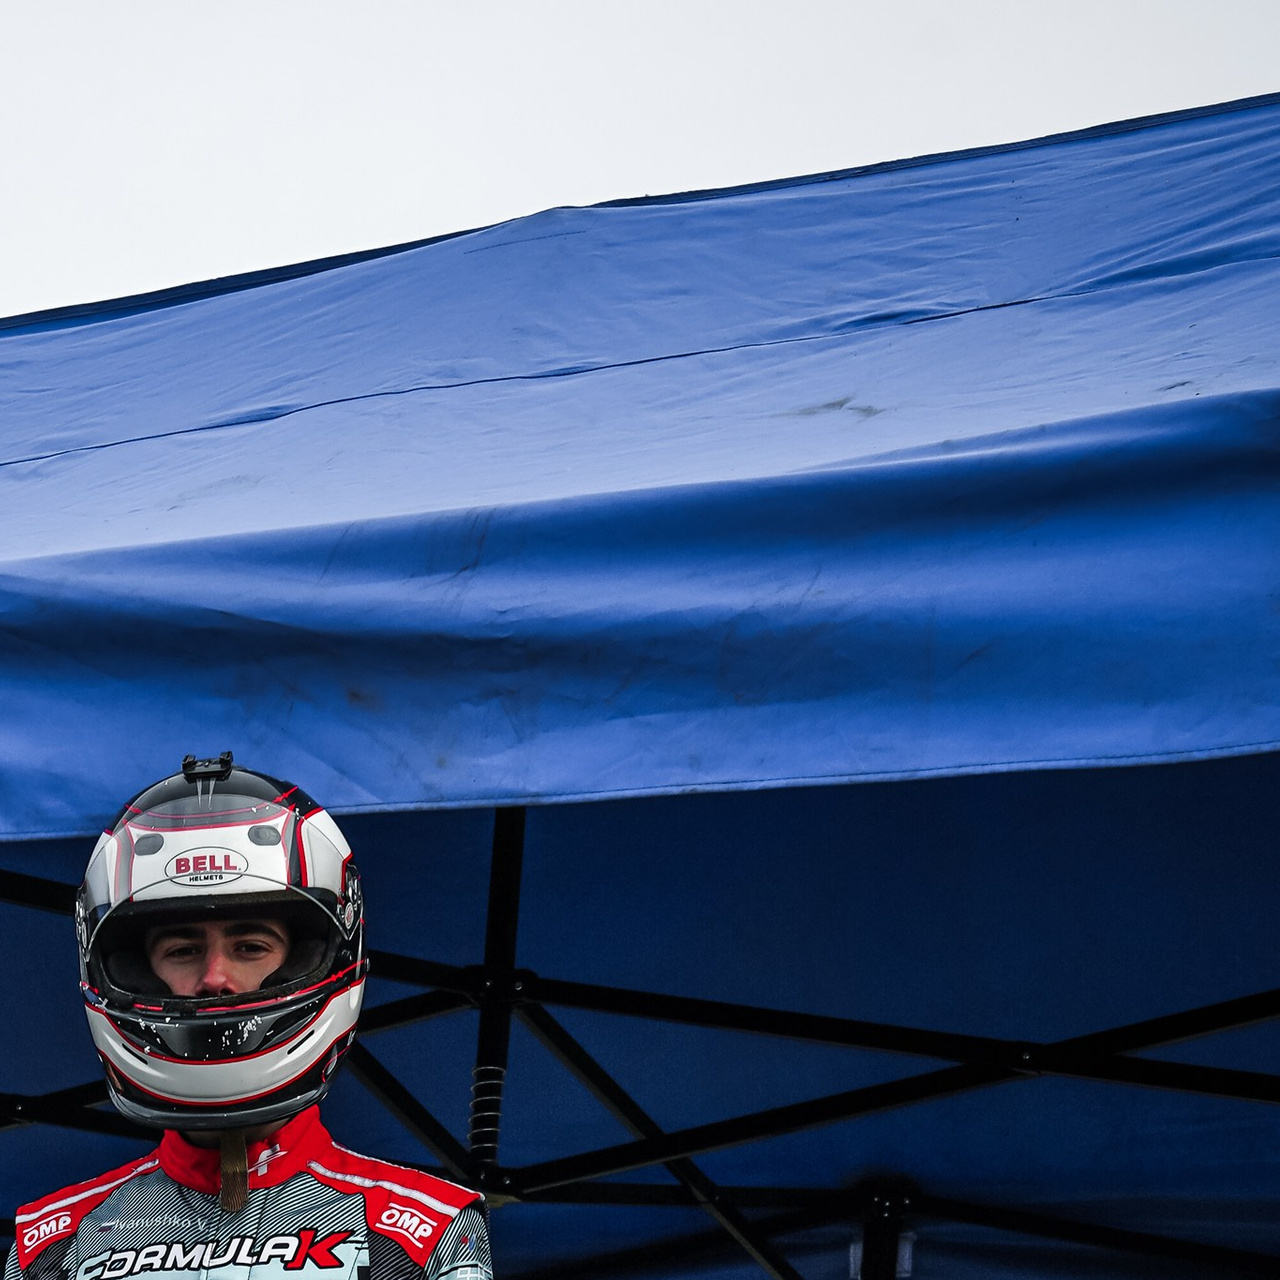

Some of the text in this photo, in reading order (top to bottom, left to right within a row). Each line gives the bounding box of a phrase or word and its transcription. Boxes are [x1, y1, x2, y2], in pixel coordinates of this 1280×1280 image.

[175, 855, 237, 874] BELL
[23, 1216, 71, 1247] OMP
[381, 1209, 433, 1240] OMP
